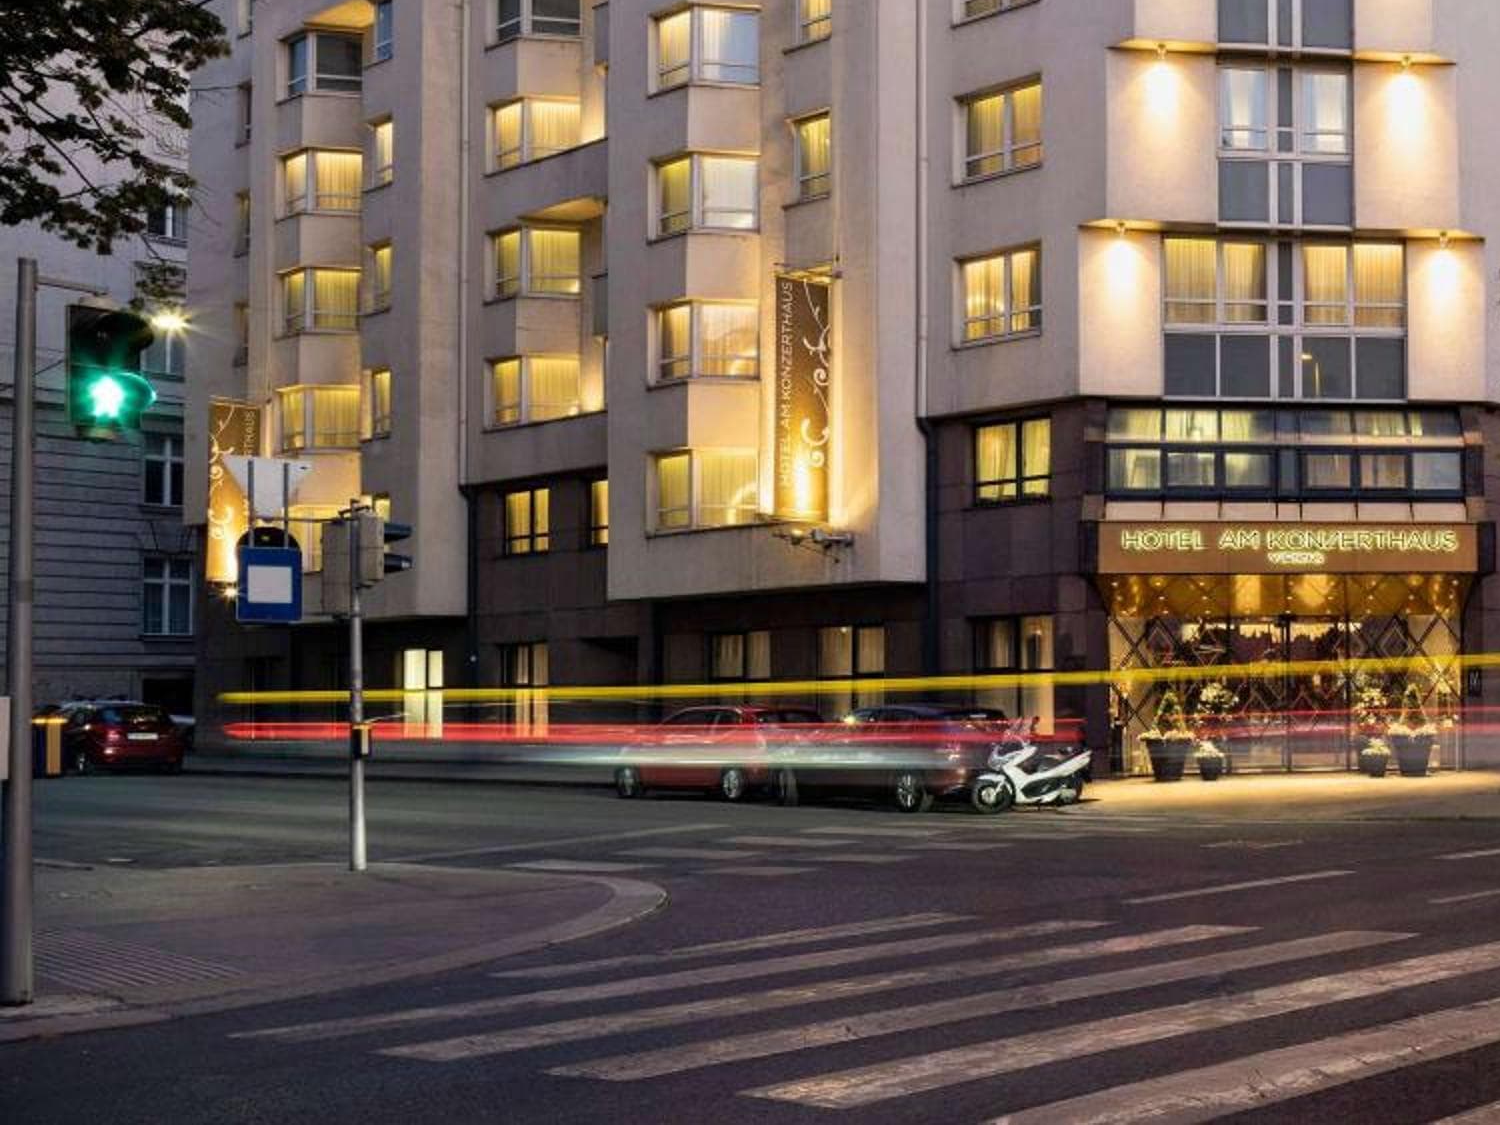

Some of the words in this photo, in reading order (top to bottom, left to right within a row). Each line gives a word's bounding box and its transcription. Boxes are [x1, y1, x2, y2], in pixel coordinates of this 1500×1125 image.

[780, 281, 794, 401] KONZERTHAUS
[780, 404, 790, 429] AM
[1121, 530, 1207, 551] HOTEL
[1218, 530, 1262, 551] AM
[1266, 530, 1459, 552] KONZERTHAUS
